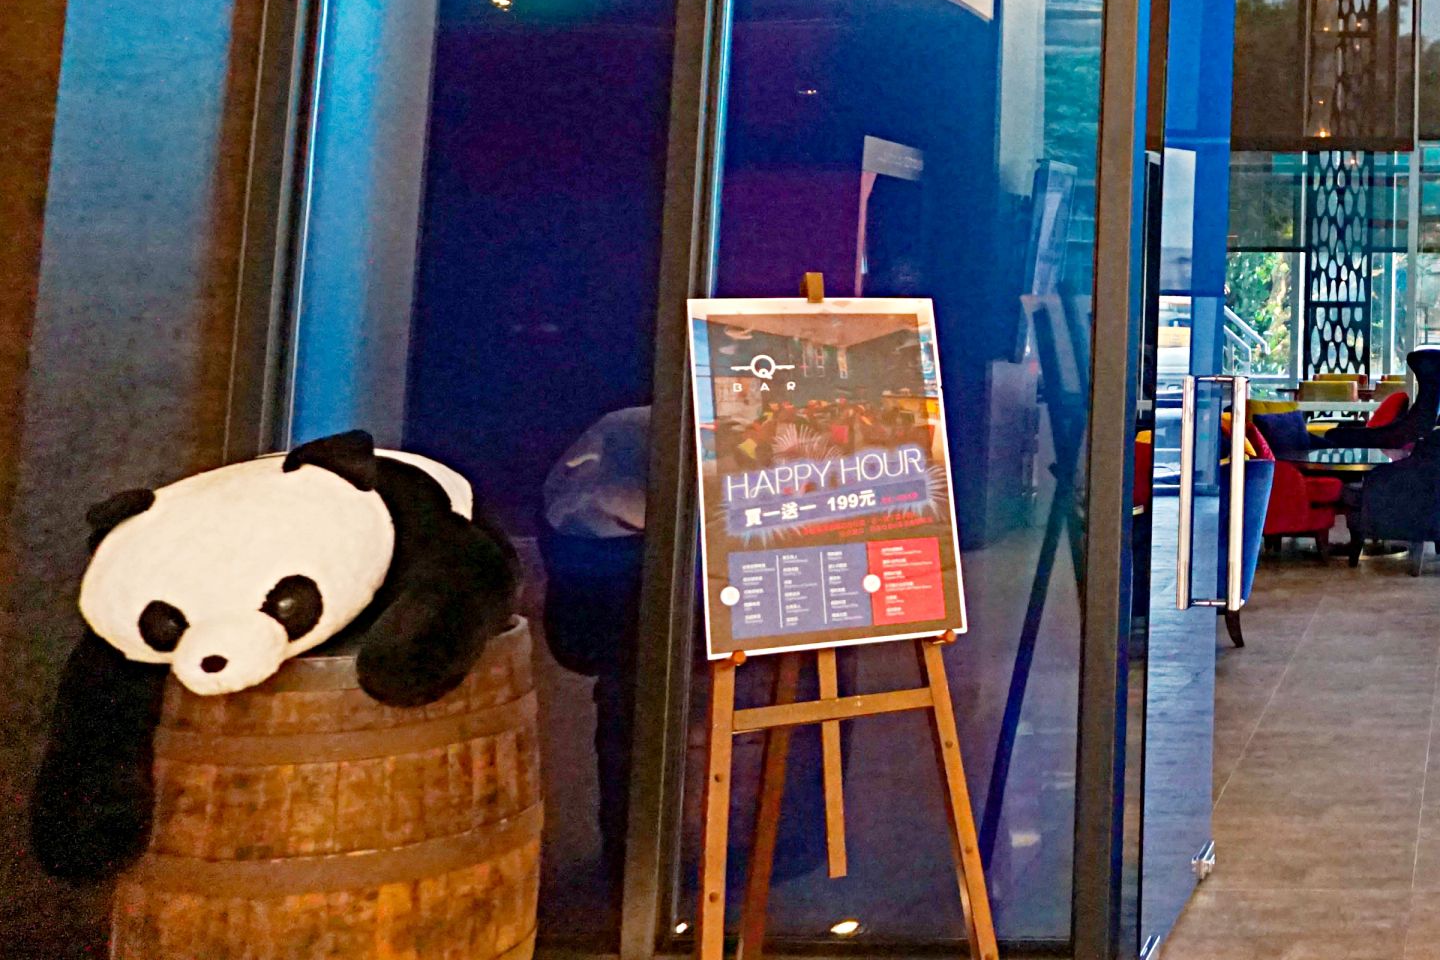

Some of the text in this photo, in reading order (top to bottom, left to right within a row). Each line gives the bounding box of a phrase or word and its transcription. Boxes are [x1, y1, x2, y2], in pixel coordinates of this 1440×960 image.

[732, 381, 796, 392] BAR
[727, 447, 925, 502] HAPPY HOUR
[744, 501, 817, 527] 買一送一
[827, 489, 876, 512] 199元
